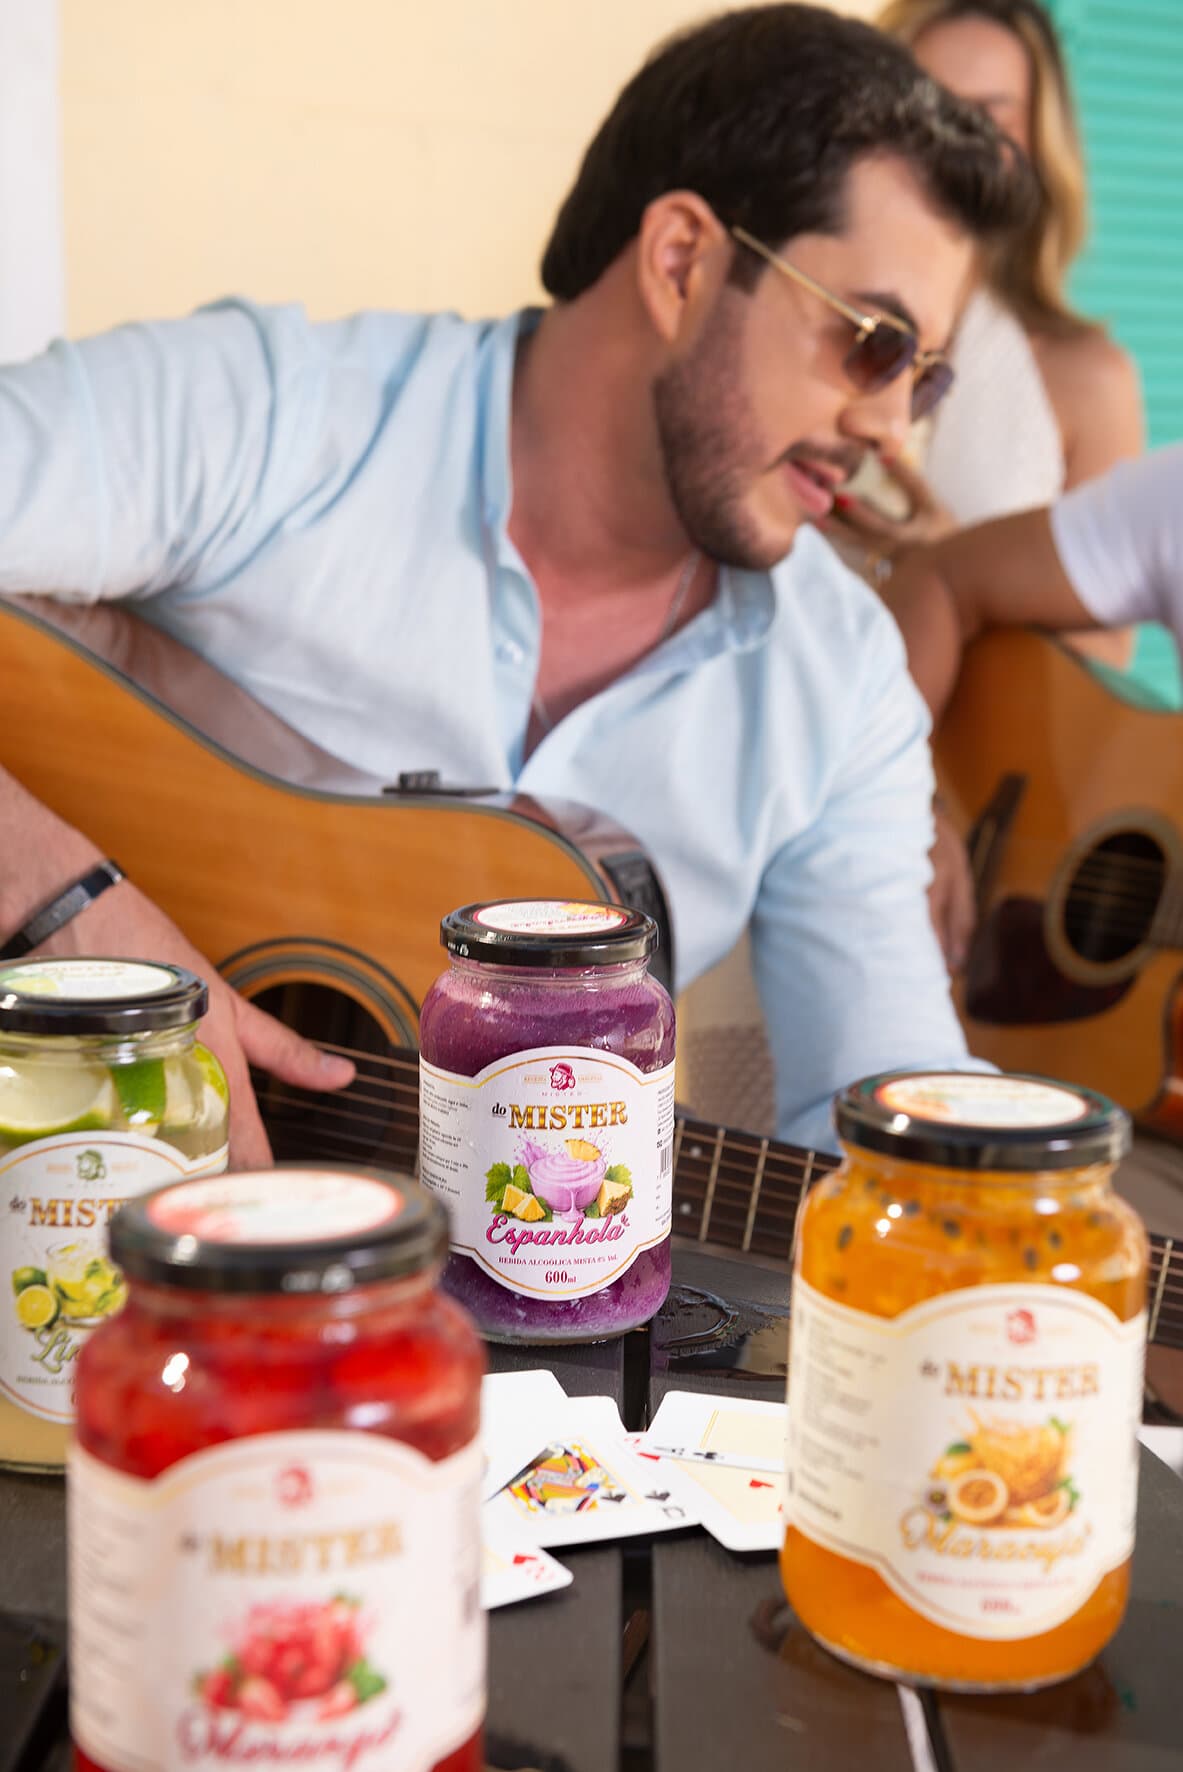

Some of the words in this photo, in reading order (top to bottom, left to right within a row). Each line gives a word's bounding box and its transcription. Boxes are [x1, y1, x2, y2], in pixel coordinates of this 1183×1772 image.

[491, 1102, 507, 1116] do
[508, 1101, 628, 1130] MISTER
[29, 1197, 129, 1228] MIST
[486, 1213, 629, 1255] Espanhola
[498, 1256, 527, 1266] BEBIDA
[545, 1270, 576, 1284] 600ml
[946, 1361, 1100, 1402] MISTER
